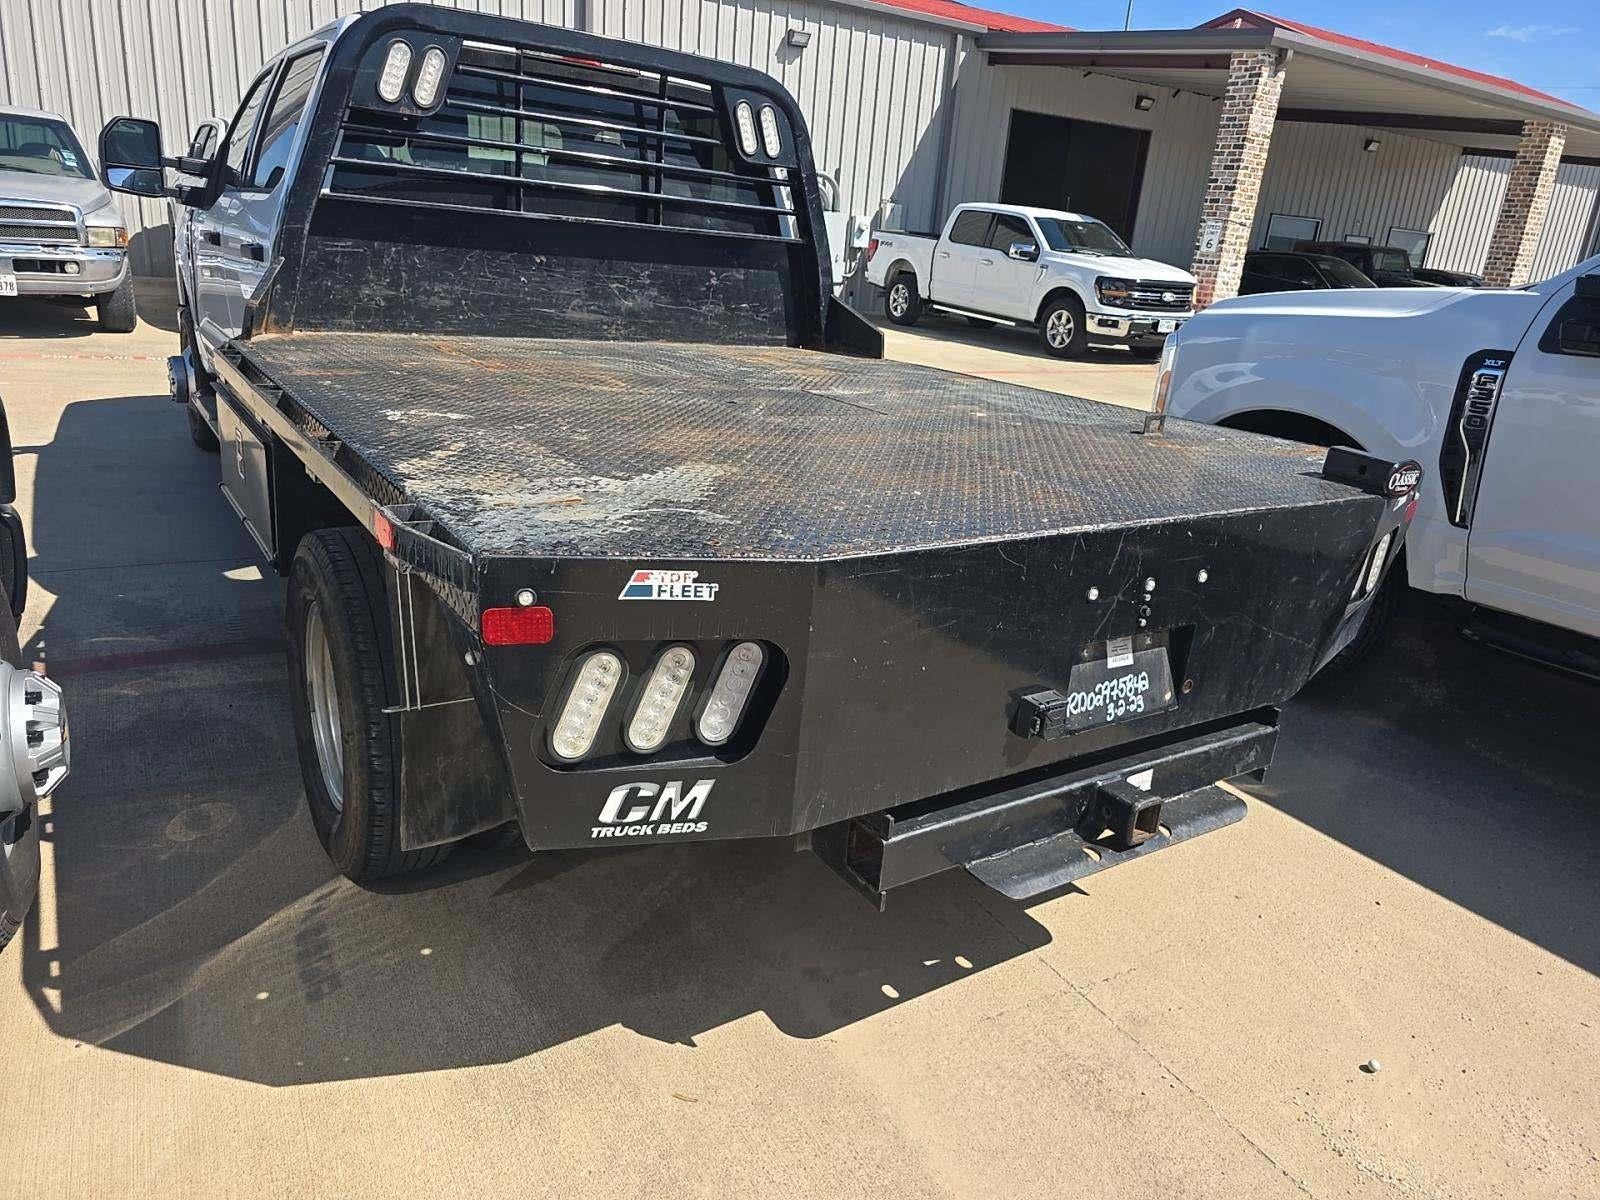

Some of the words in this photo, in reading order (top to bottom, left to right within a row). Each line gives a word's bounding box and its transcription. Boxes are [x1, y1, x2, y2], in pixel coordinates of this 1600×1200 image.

[1206, 239, 1213, 249] 6
[1483, 359, 1505, 367] XLT
[657, 584, 718, 599] FLEET
[598, 778, 716, 823] CM
[591, 824, 656, 838] TRUCK
[656, 821, 709, 835] BEDS
